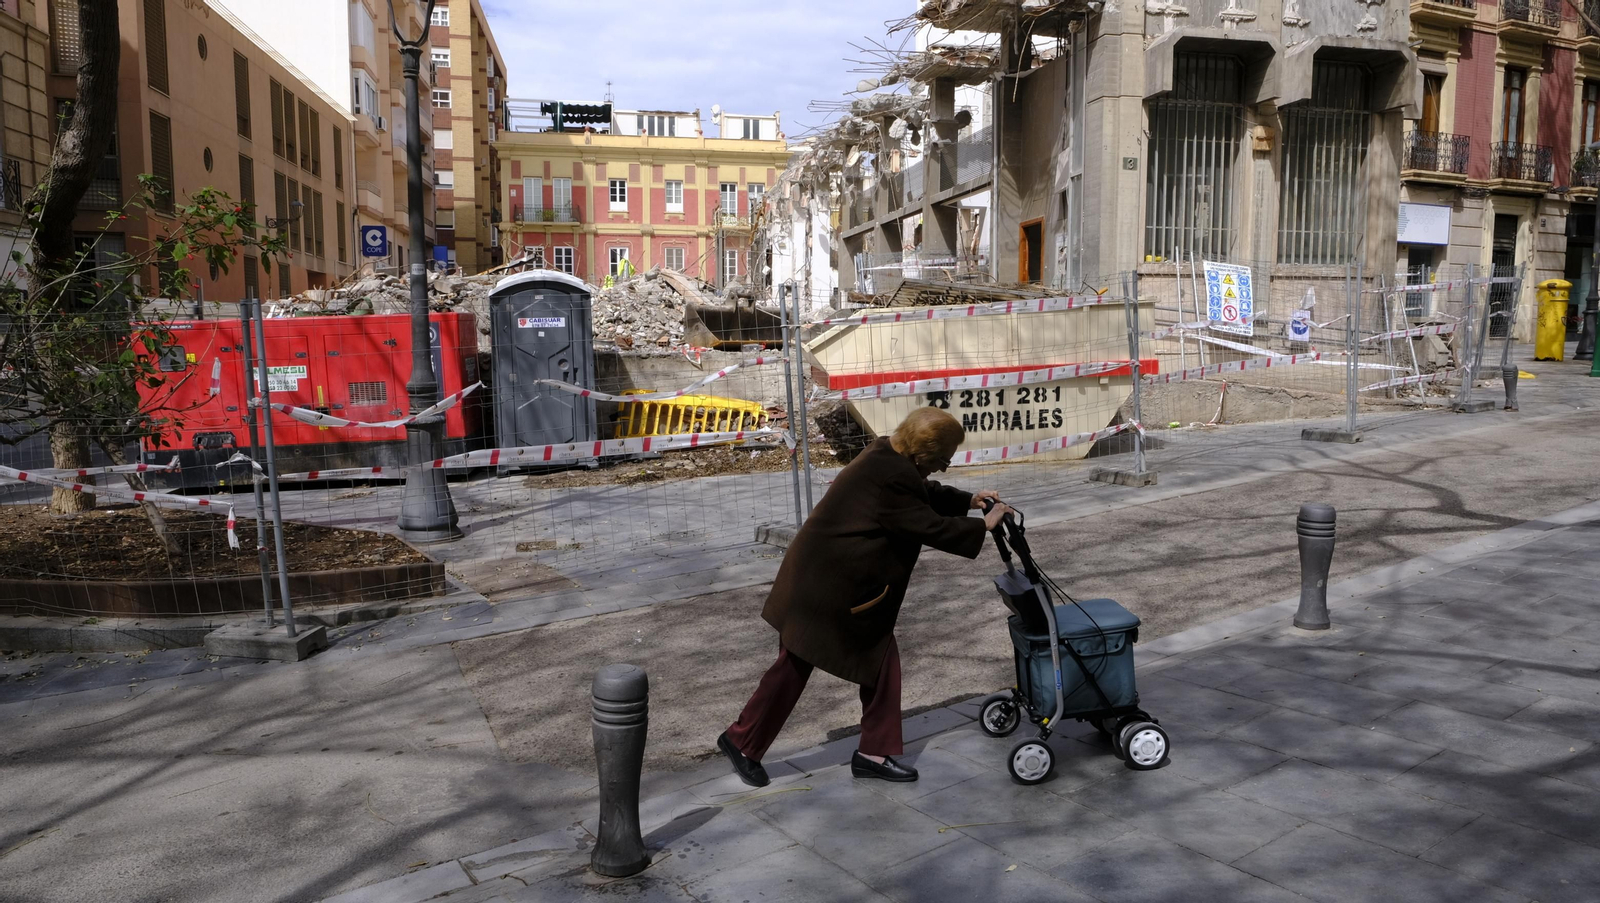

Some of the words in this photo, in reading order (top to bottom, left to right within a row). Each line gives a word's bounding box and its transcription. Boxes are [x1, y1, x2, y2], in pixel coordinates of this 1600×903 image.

[960, 388, 1005, 408] 281
[1017, 386, 1061, 405] 281
[962, 407, 1063, 432] MORALES
